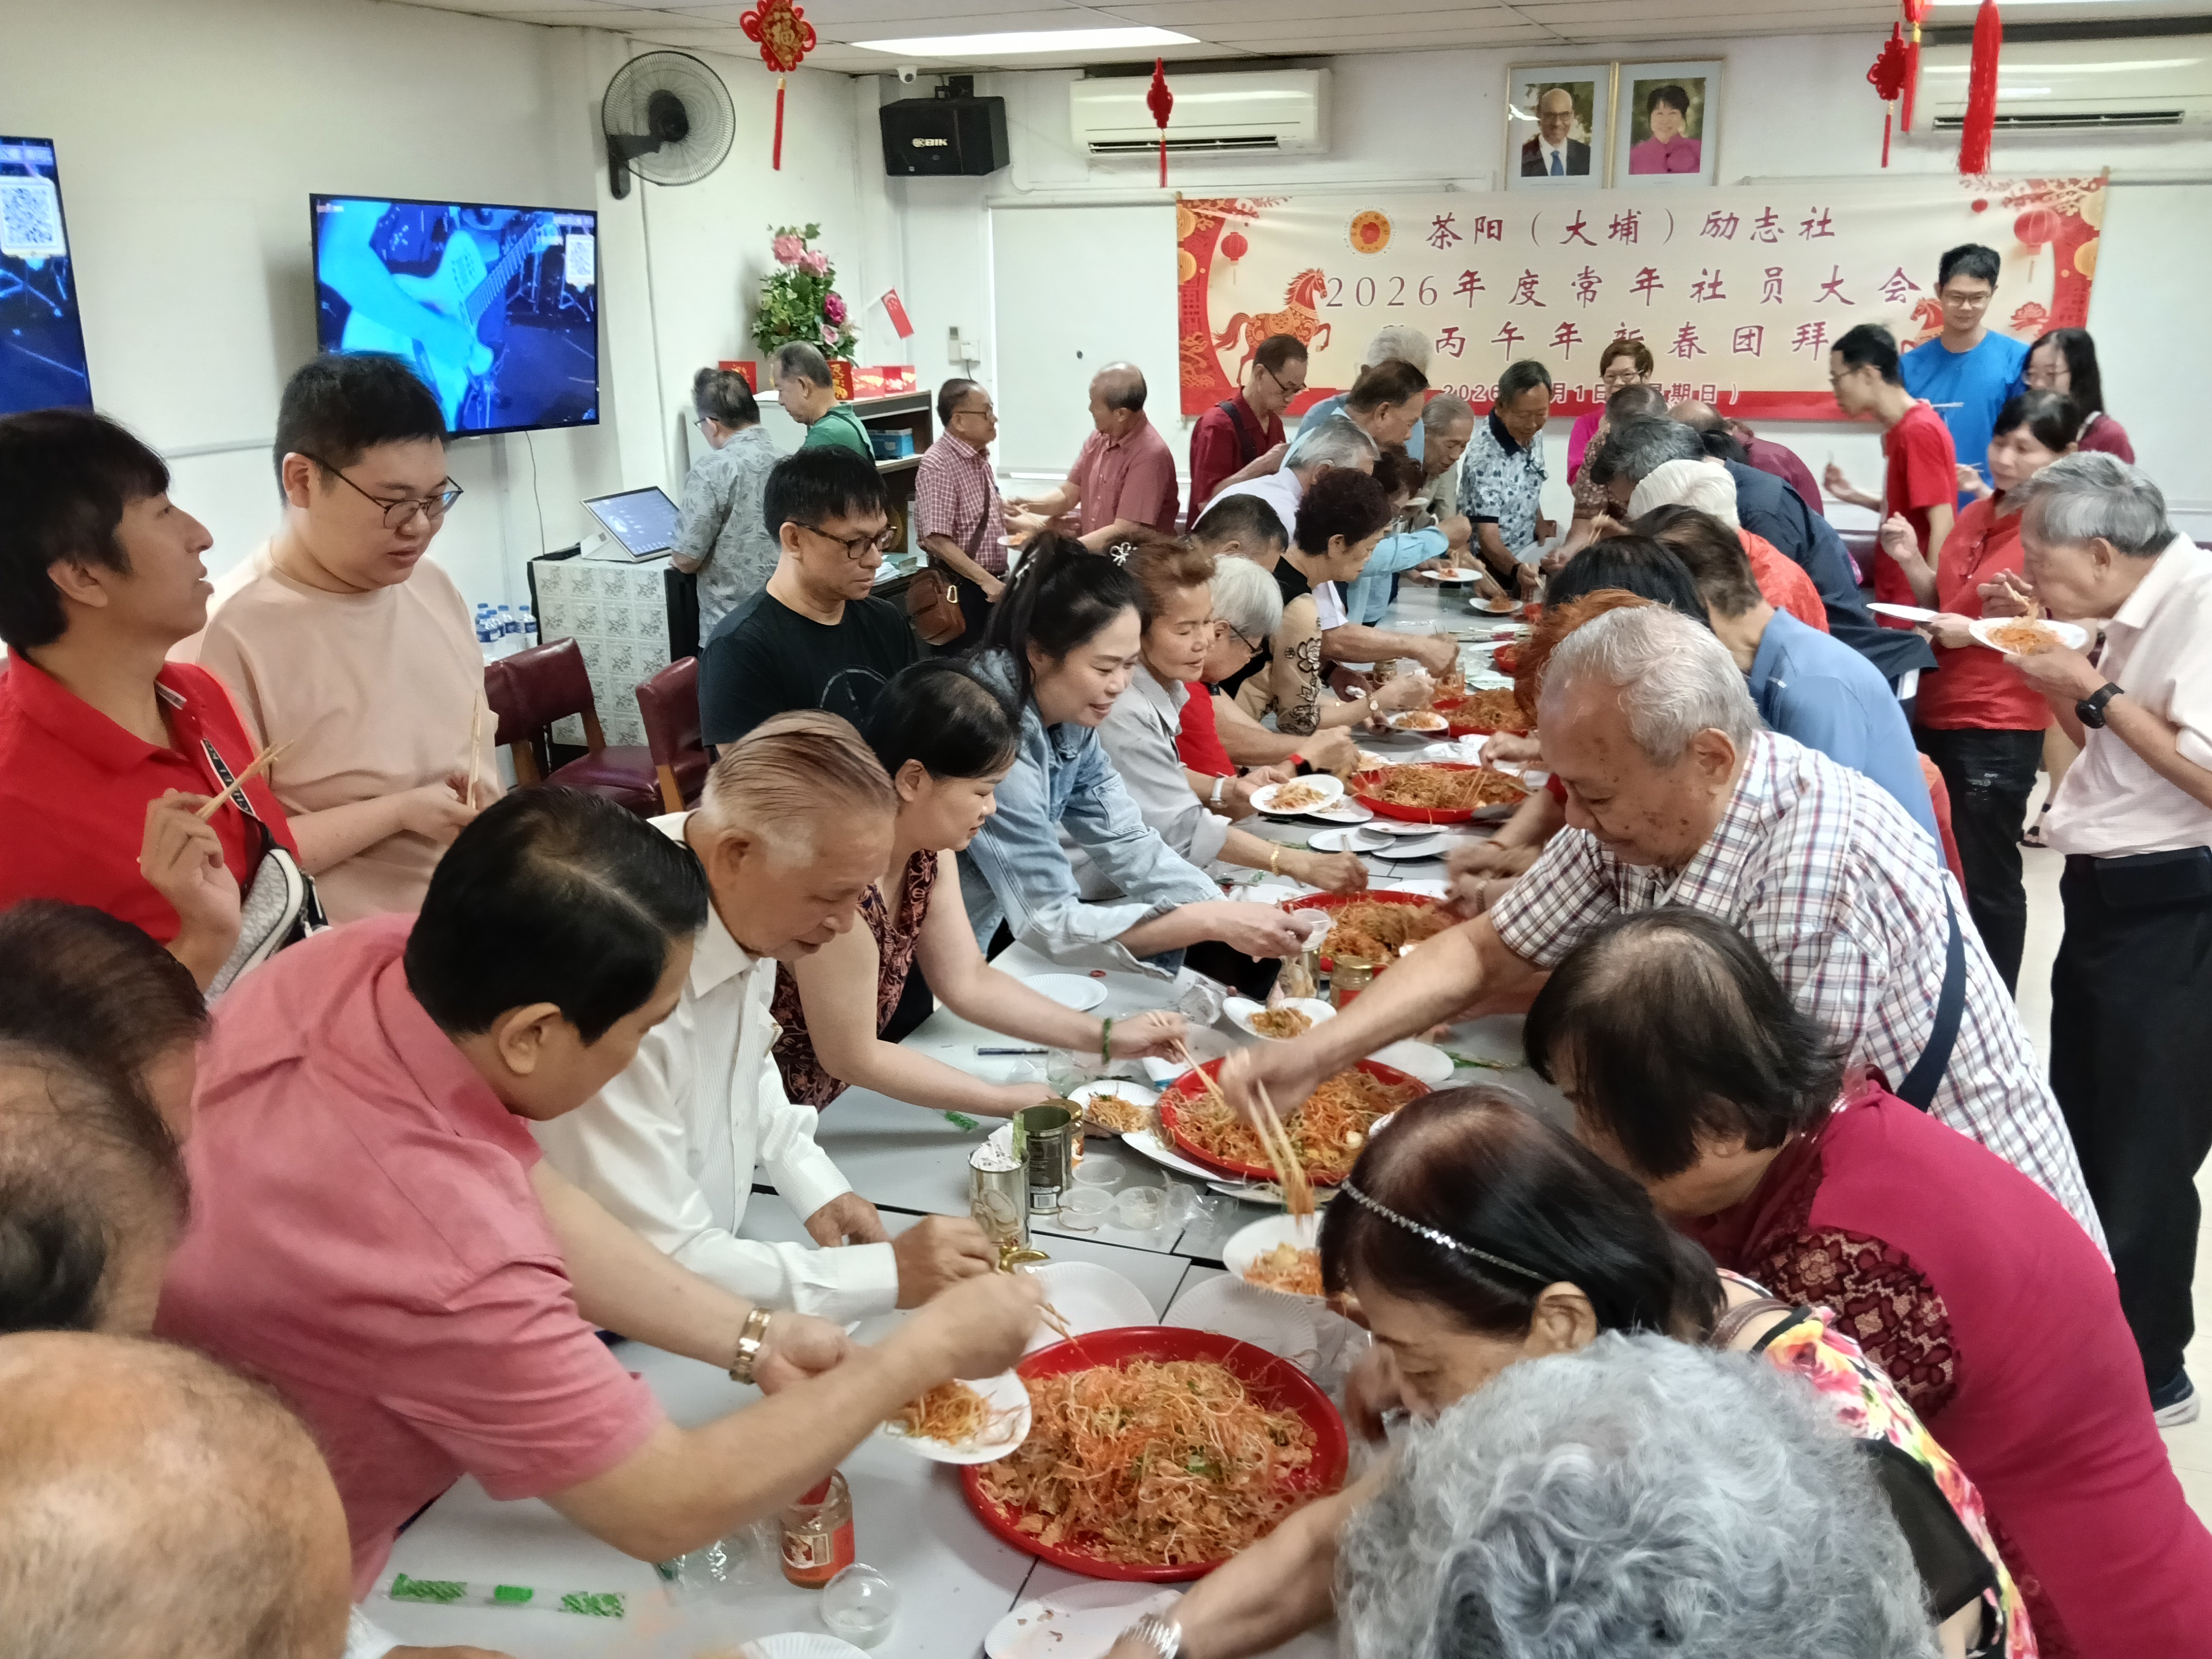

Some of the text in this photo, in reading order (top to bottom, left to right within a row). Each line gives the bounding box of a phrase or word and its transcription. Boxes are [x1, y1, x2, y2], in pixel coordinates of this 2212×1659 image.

[1325, 264, 1921, 308] 2026年度常年社员大会
[1382, 320, 1830, 361] 丙午年新春团拜
